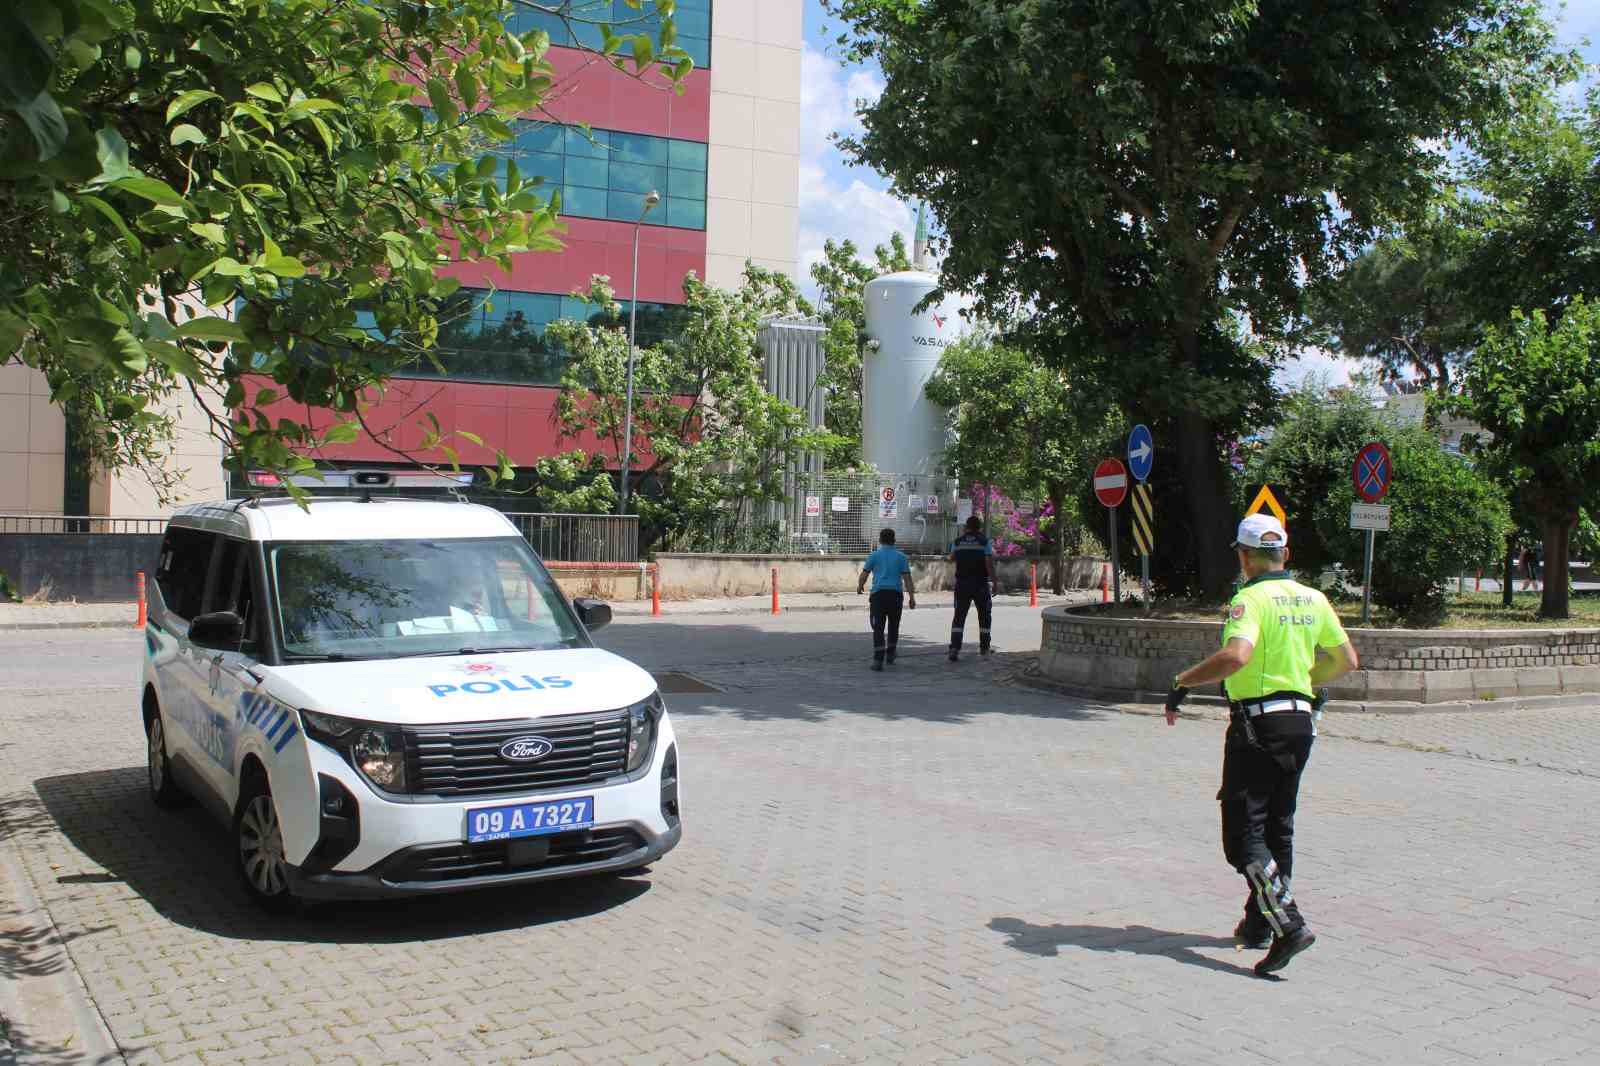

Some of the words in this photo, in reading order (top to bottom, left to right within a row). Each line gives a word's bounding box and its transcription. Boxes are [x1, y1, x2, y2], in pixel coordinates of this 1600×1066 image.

[1279, 614, 1315, 625] PLİSİ
[427, 675, 573, 697] POLİS
[511, 742, 542, 757] Ford
[475, 812, 503, 834] 09
[510, 809, 525, 830] A
[532, 802, 586, 827] 7327
